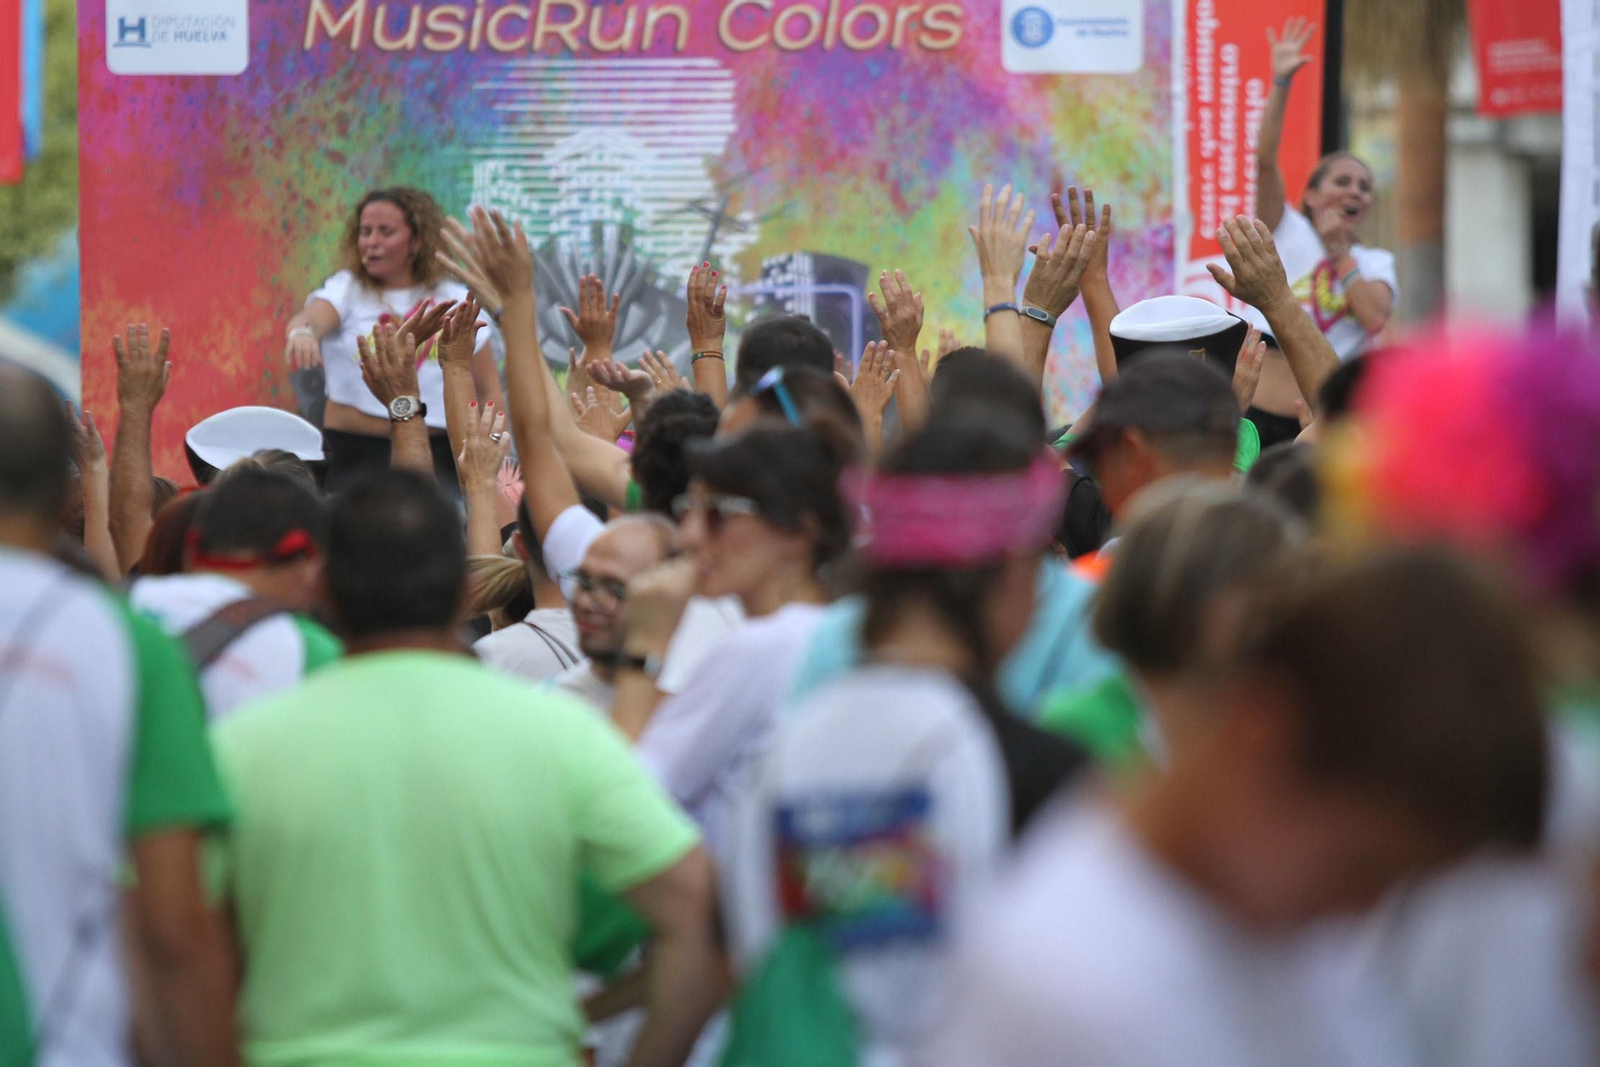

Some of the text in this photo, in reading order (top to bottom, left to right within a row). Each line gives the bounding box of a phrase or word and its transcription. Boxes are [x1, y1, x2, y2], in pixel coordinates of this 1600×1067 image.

[151, 31, 228, 42] DE HUELVA
[303, 0, 964, 51] MusicRun Colors
